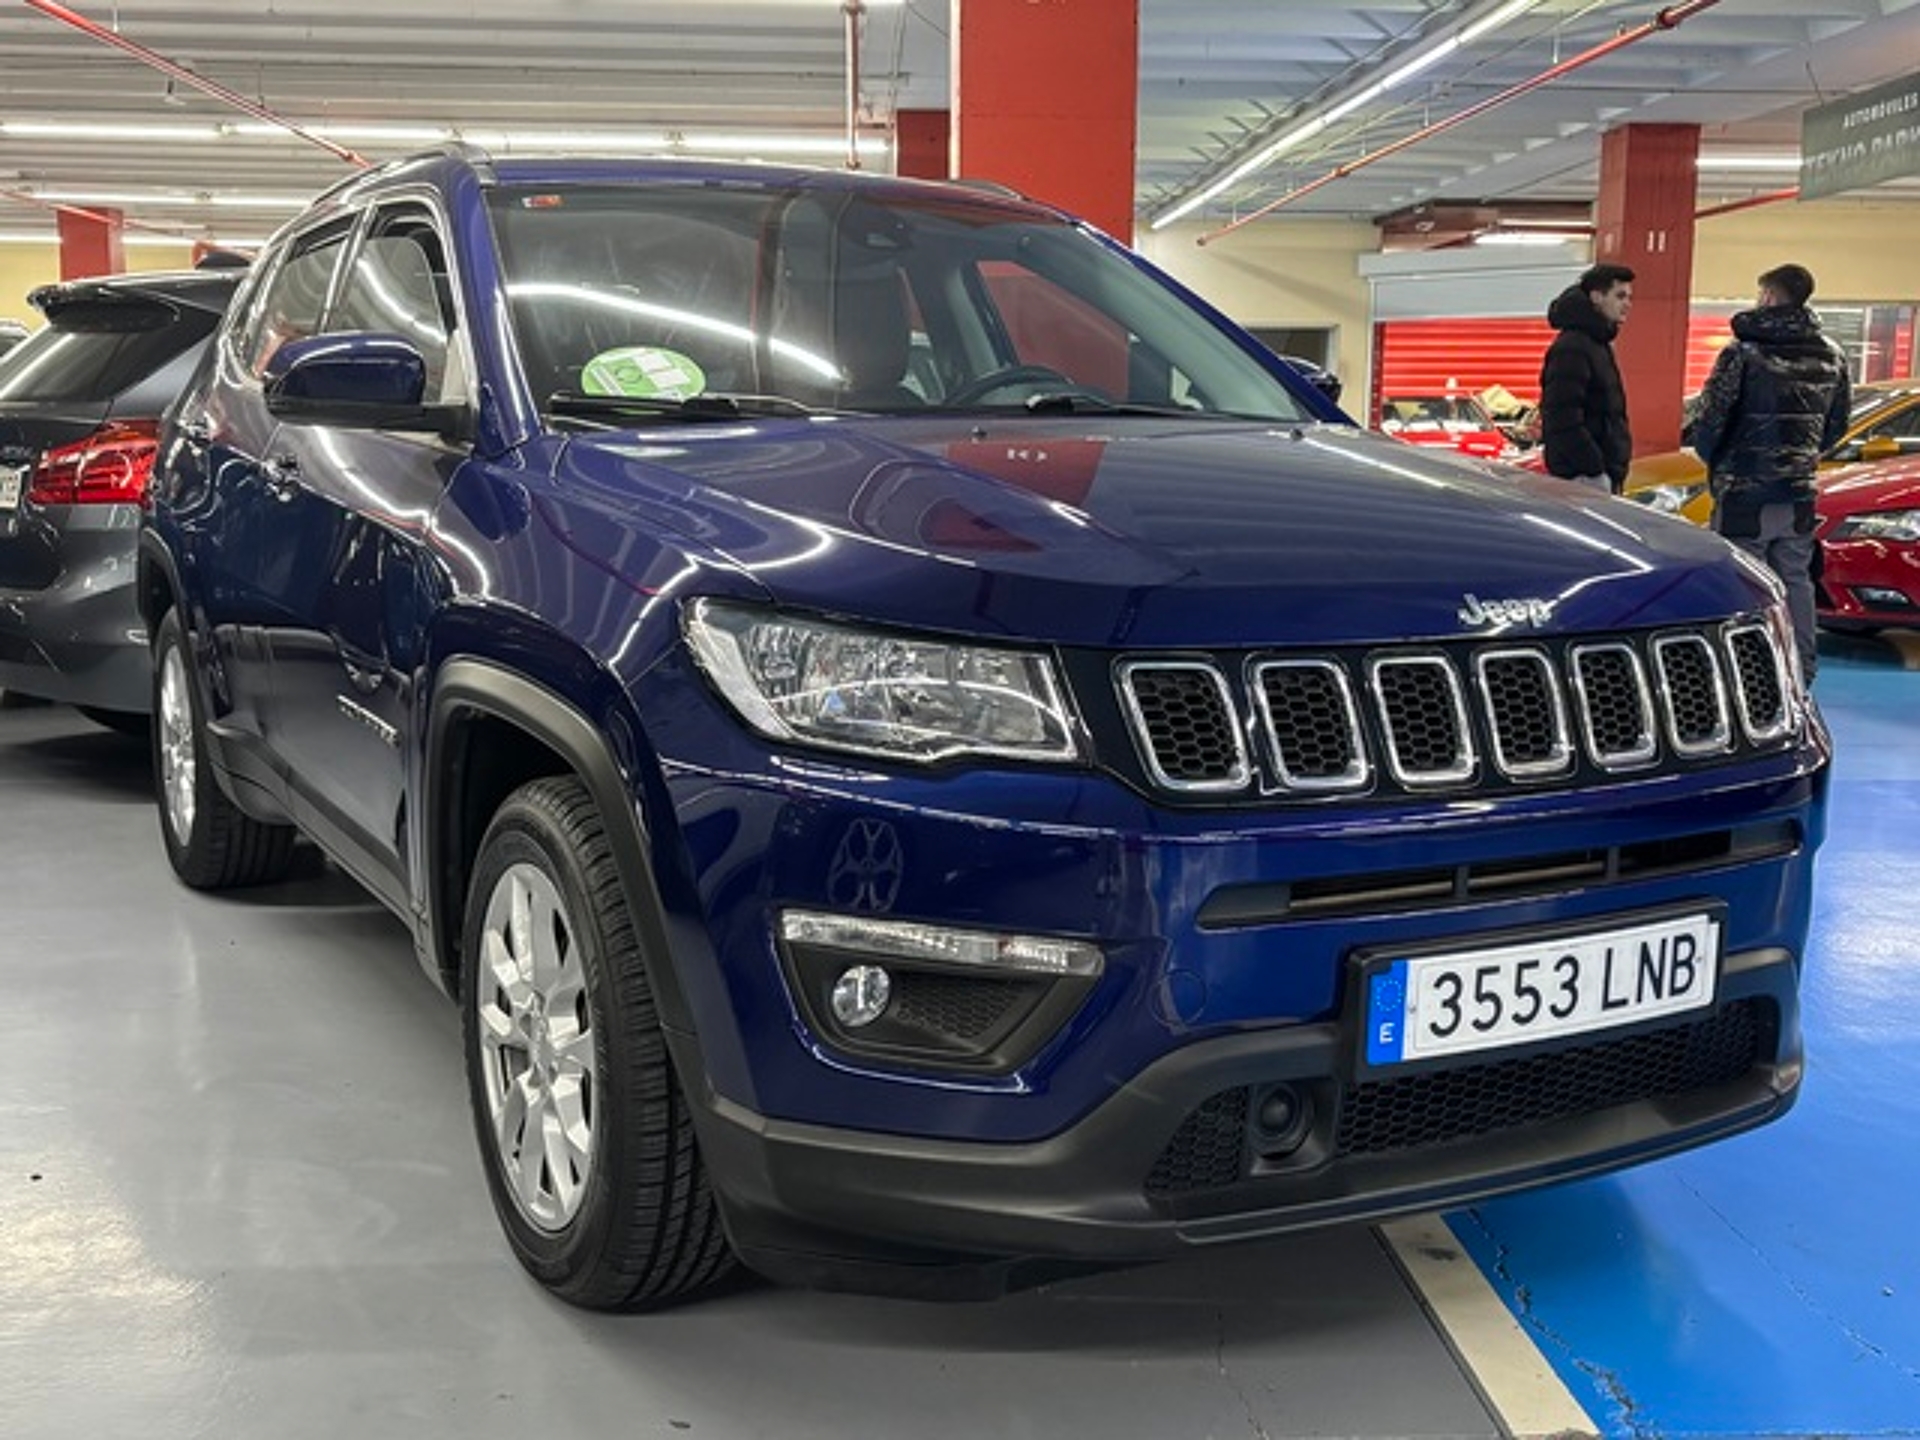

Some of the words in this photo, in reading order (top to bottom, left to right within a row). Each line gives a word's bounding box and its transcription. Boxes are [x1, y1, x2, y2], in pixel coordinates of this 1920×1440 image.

[1457, 593, 1552, 627] Jeep
[1429, 955, 1580, 1038] 3553
[1601, 932, 1698, 1012] LNB
[1379, 1022, 1395, 1044] E
